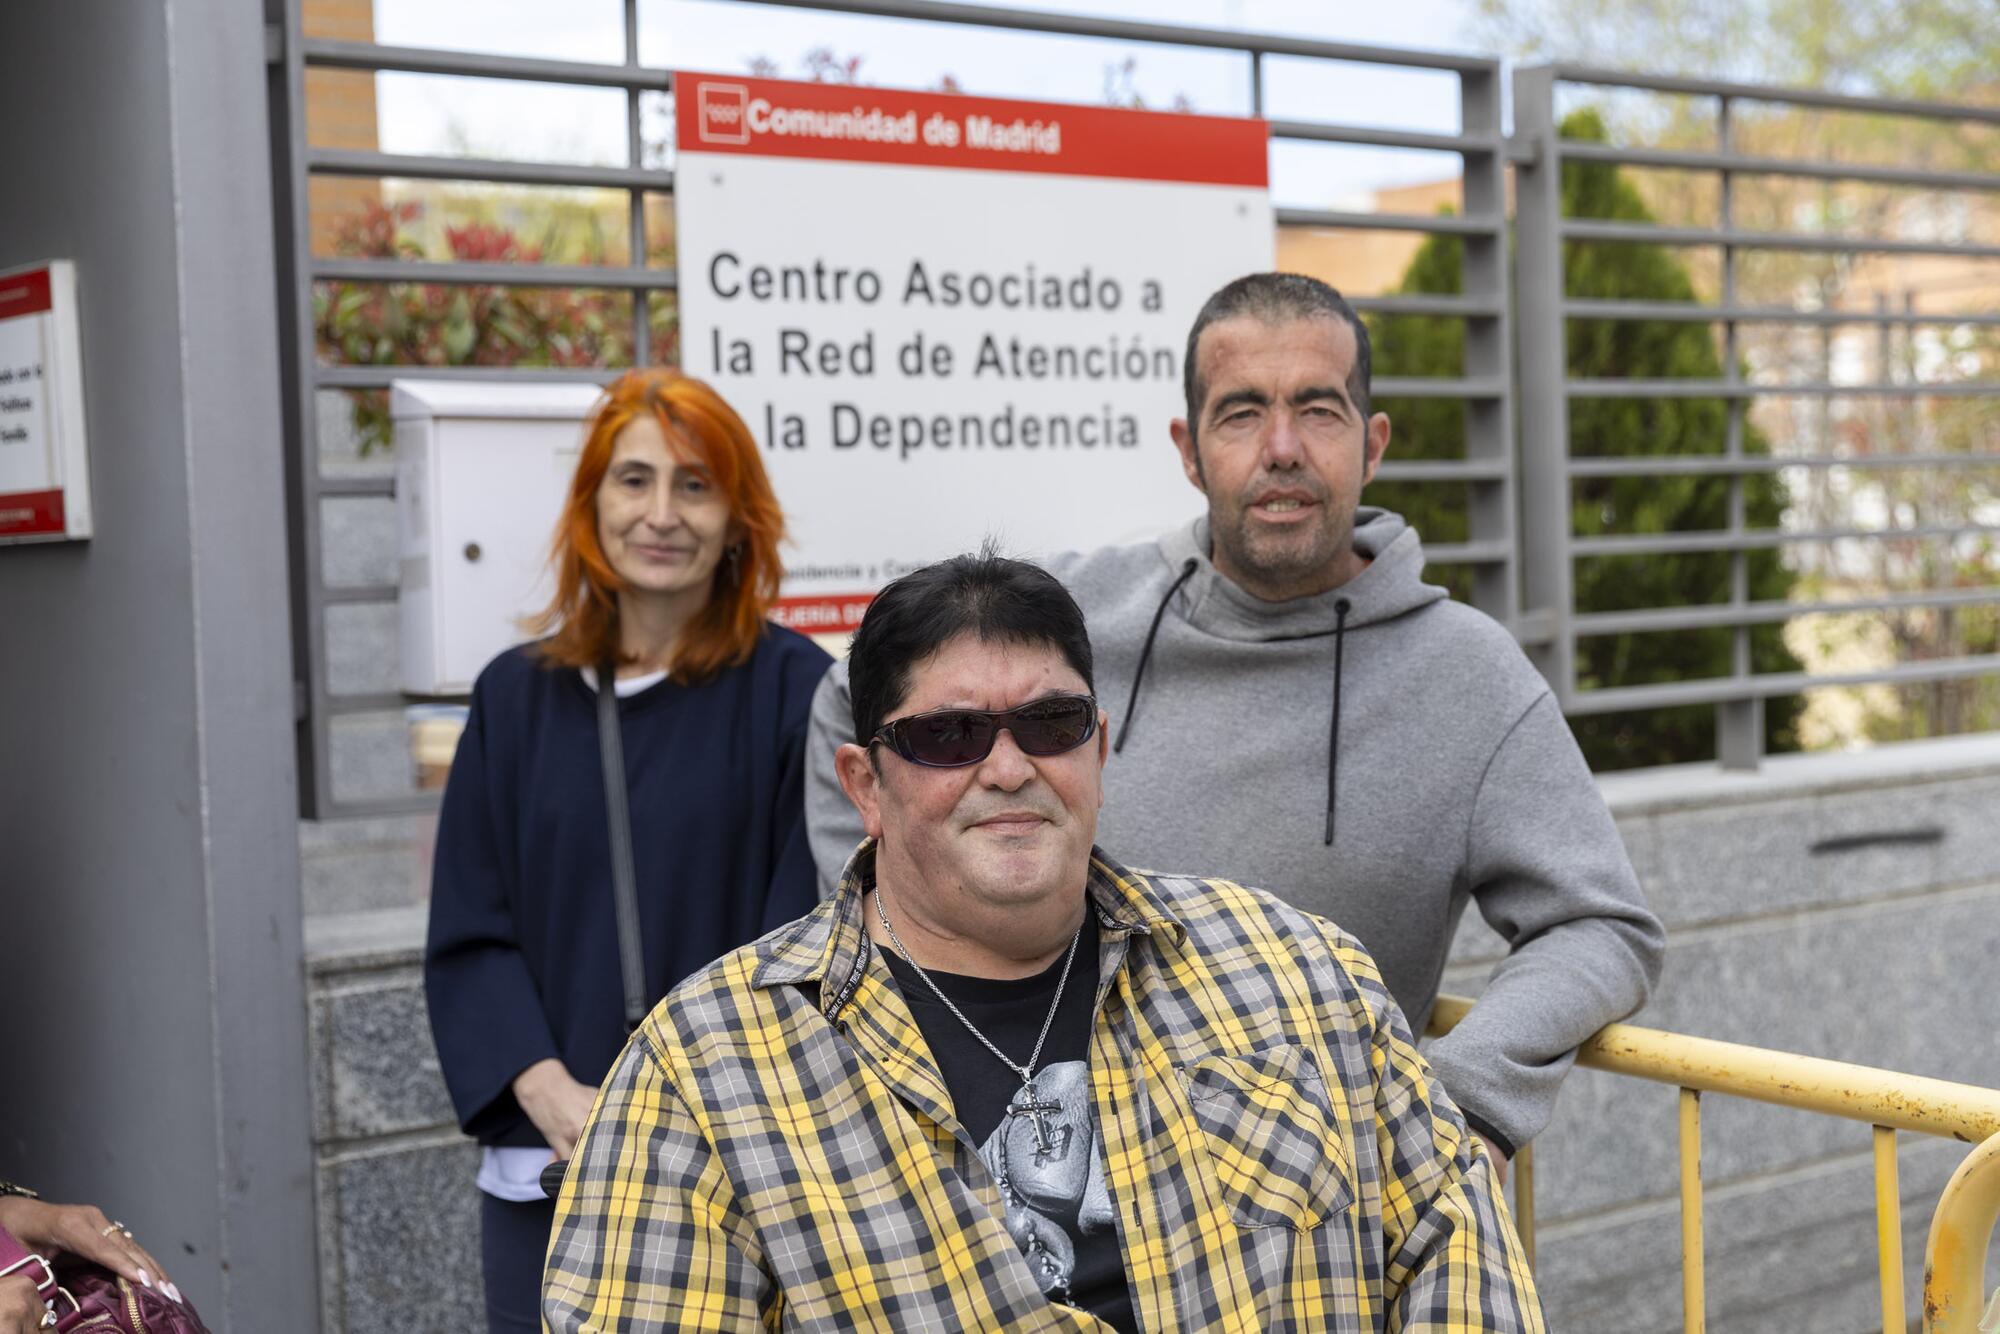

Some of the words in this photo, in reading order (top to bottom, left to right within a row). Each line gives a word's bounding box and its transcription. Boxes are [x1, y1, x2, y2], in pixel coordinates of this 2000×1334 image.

[747, 98, 917, 144] Comunidad
[922, 112, 961, 148] de
[965, 114, 1061, 155] Madrid
[708, 251, 882, 303] Centro
[903, 260, 1122, 311] Asociado
[1141, 280, 1163, 312] a
[711, 328, 754, 374] la
[778, 328, 875, 376] Red
[897, 332, 954, 377] de
[973, 333, 1176, 379] Atención
[765, 403, 806, 449] la
[831, 403, 1139, 459] Dependencia
